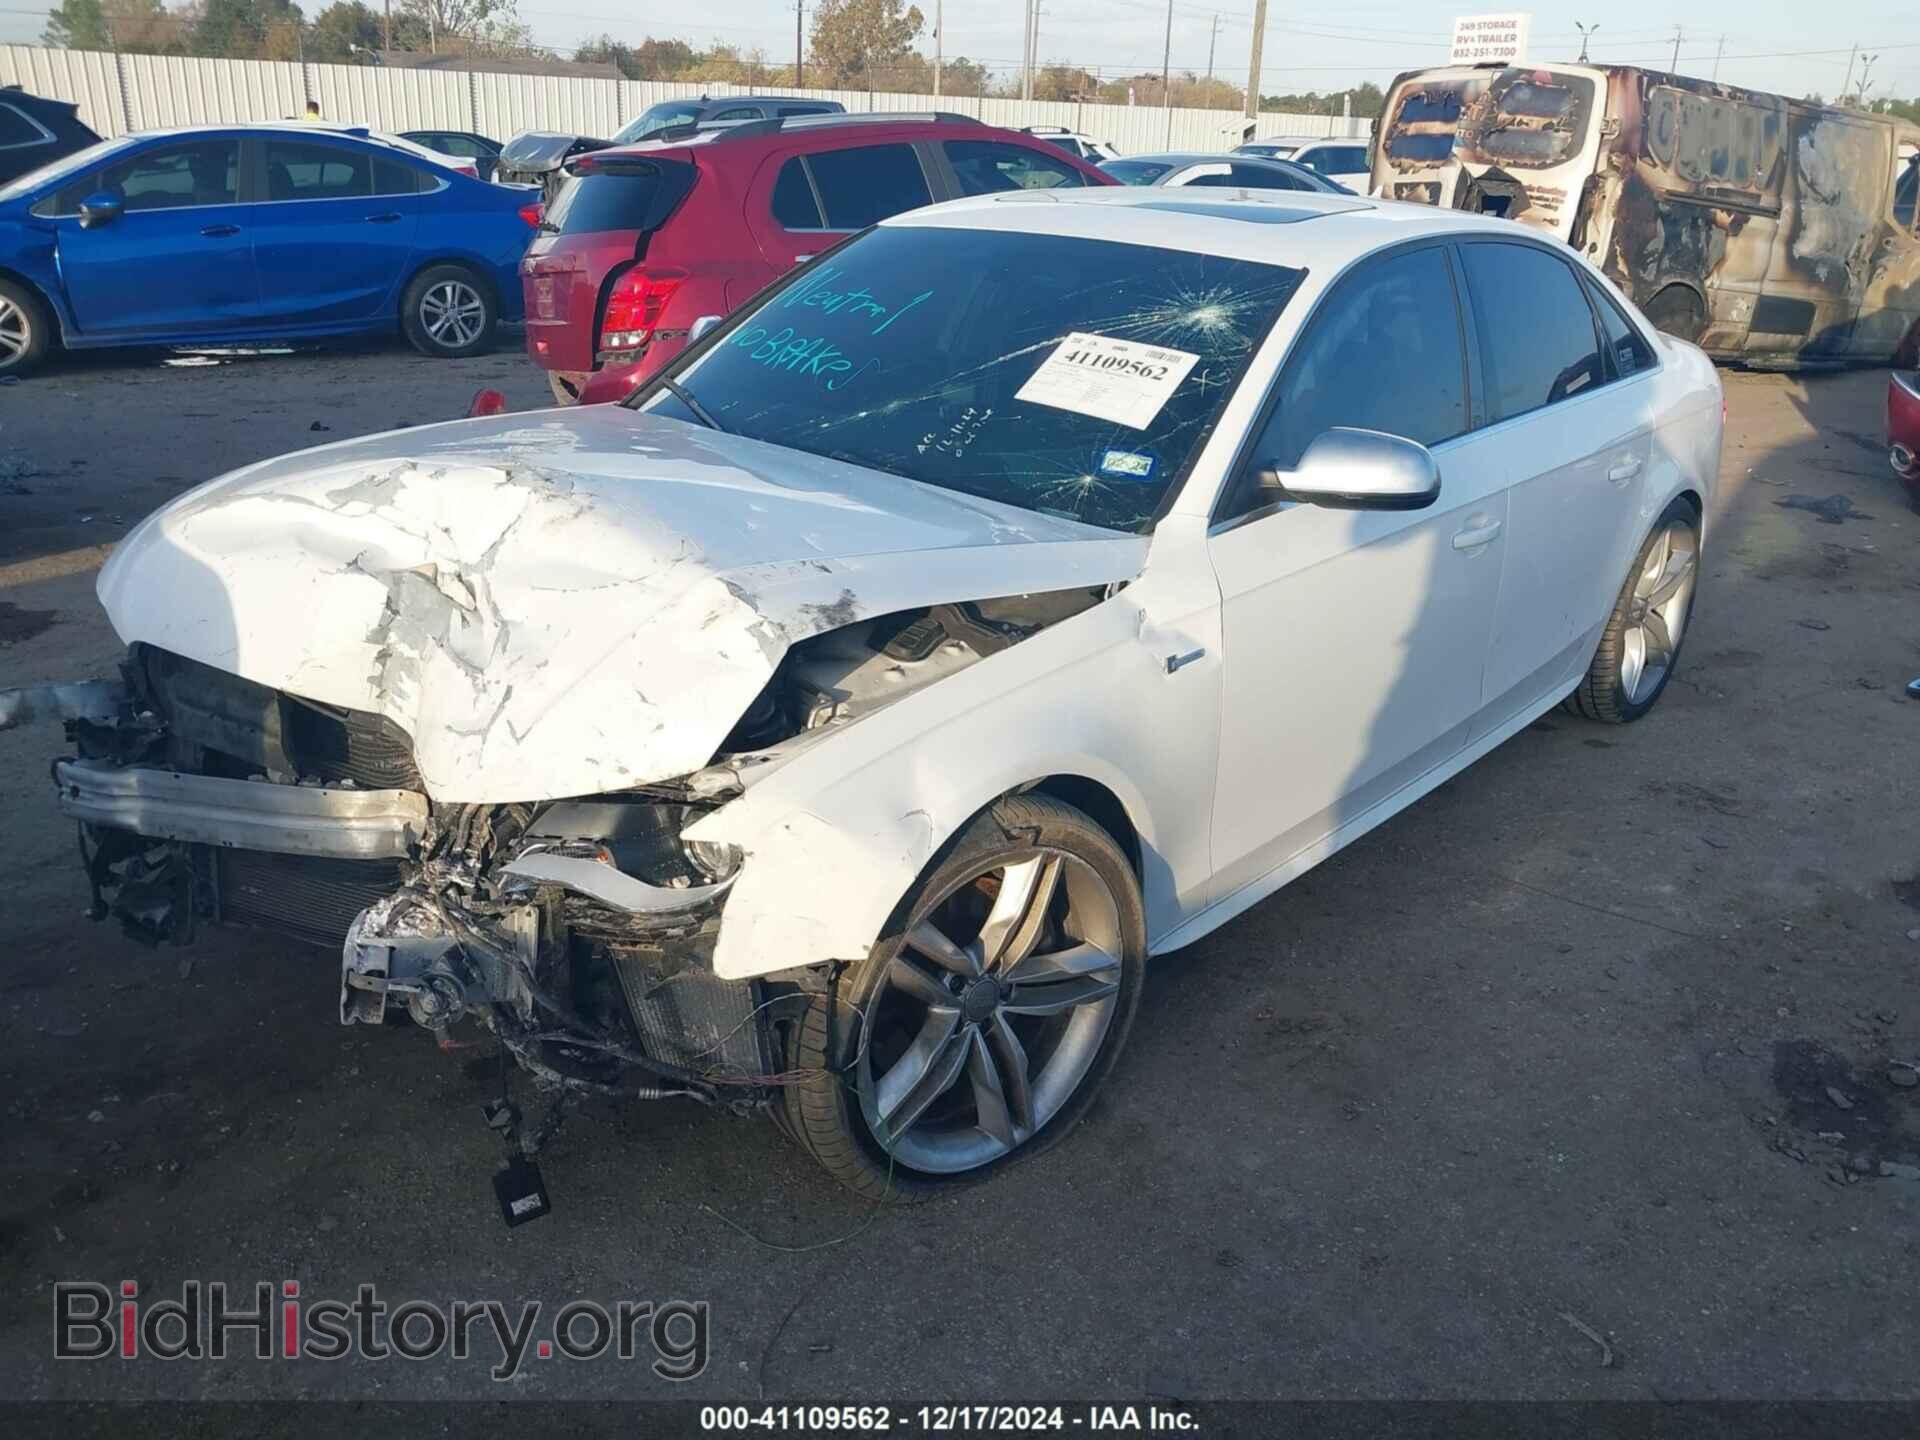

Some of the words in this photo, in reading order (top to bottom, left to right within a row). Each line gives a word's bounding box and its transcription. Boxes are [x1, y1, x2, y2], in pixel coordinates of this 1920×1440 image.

[1477, 19, 1518, 30] STORAGE
[1456, 34, 1470, 44] RV
[1477, 33, 1517, 43] TRAILER
[1453, 47, 1517, 58] 832-251-7300
[1064, 349, 1169, 381] 41109562
